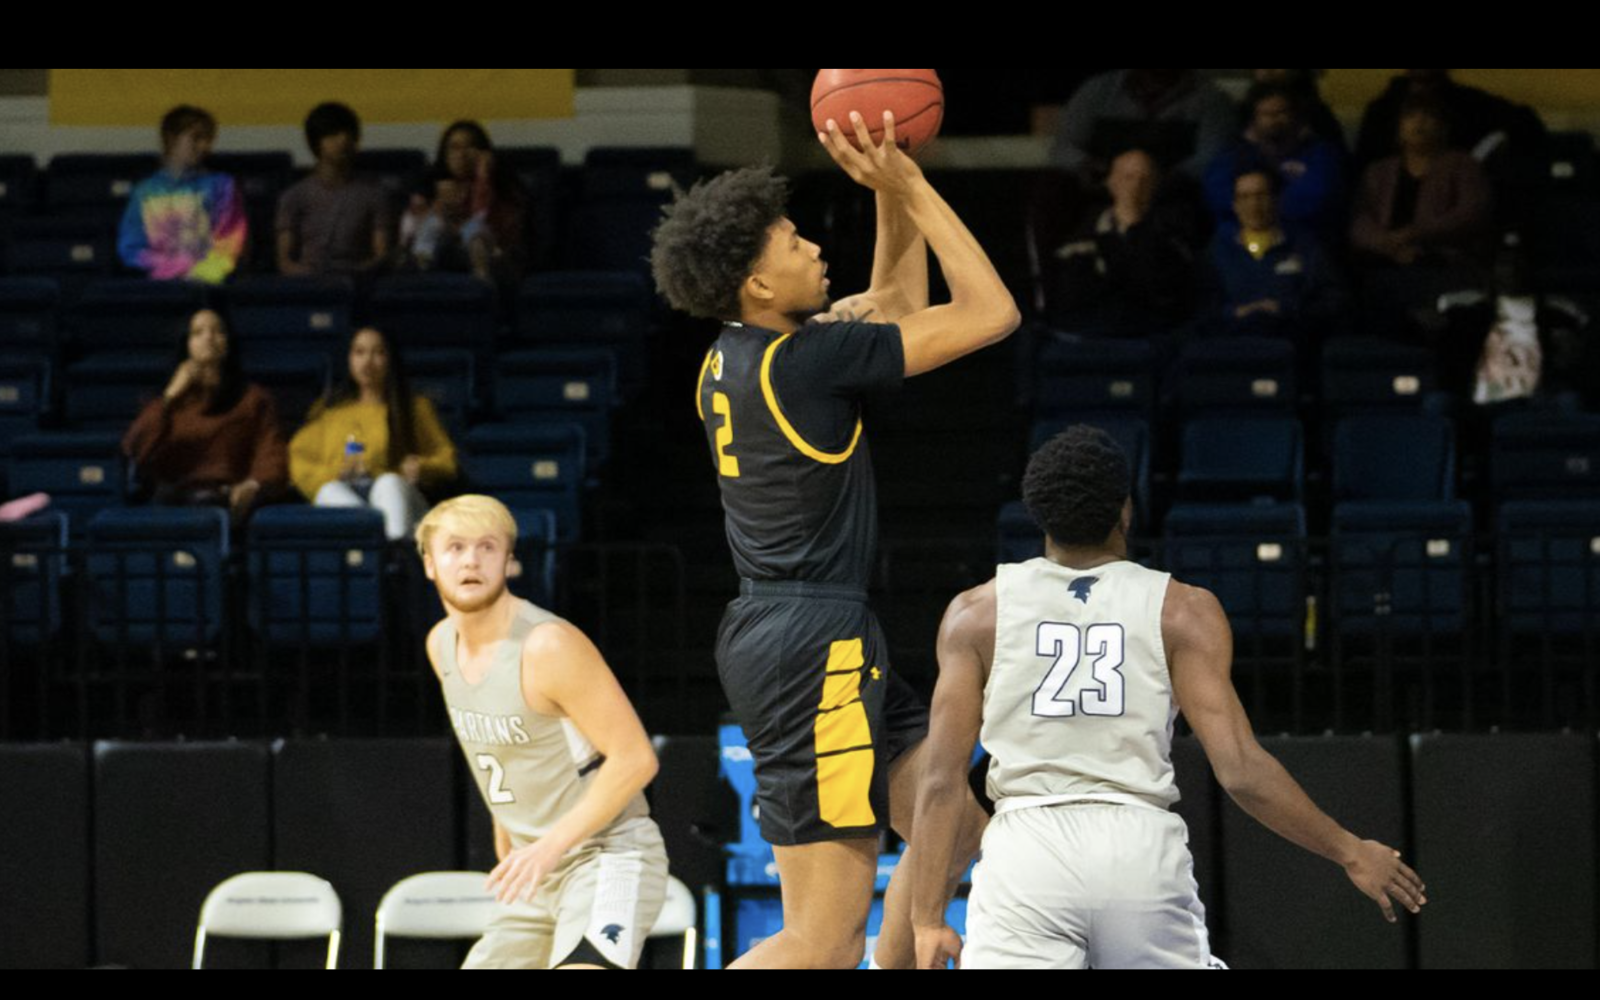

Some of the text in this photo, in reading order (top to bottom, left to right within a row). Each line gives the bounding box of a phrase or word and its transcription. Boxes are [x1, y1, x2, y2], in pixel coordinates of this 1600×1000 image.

[712, 391, 741, 477] 2
[1031, 621, 1125, 718] 23
[476, 753, 516, 805] 2
